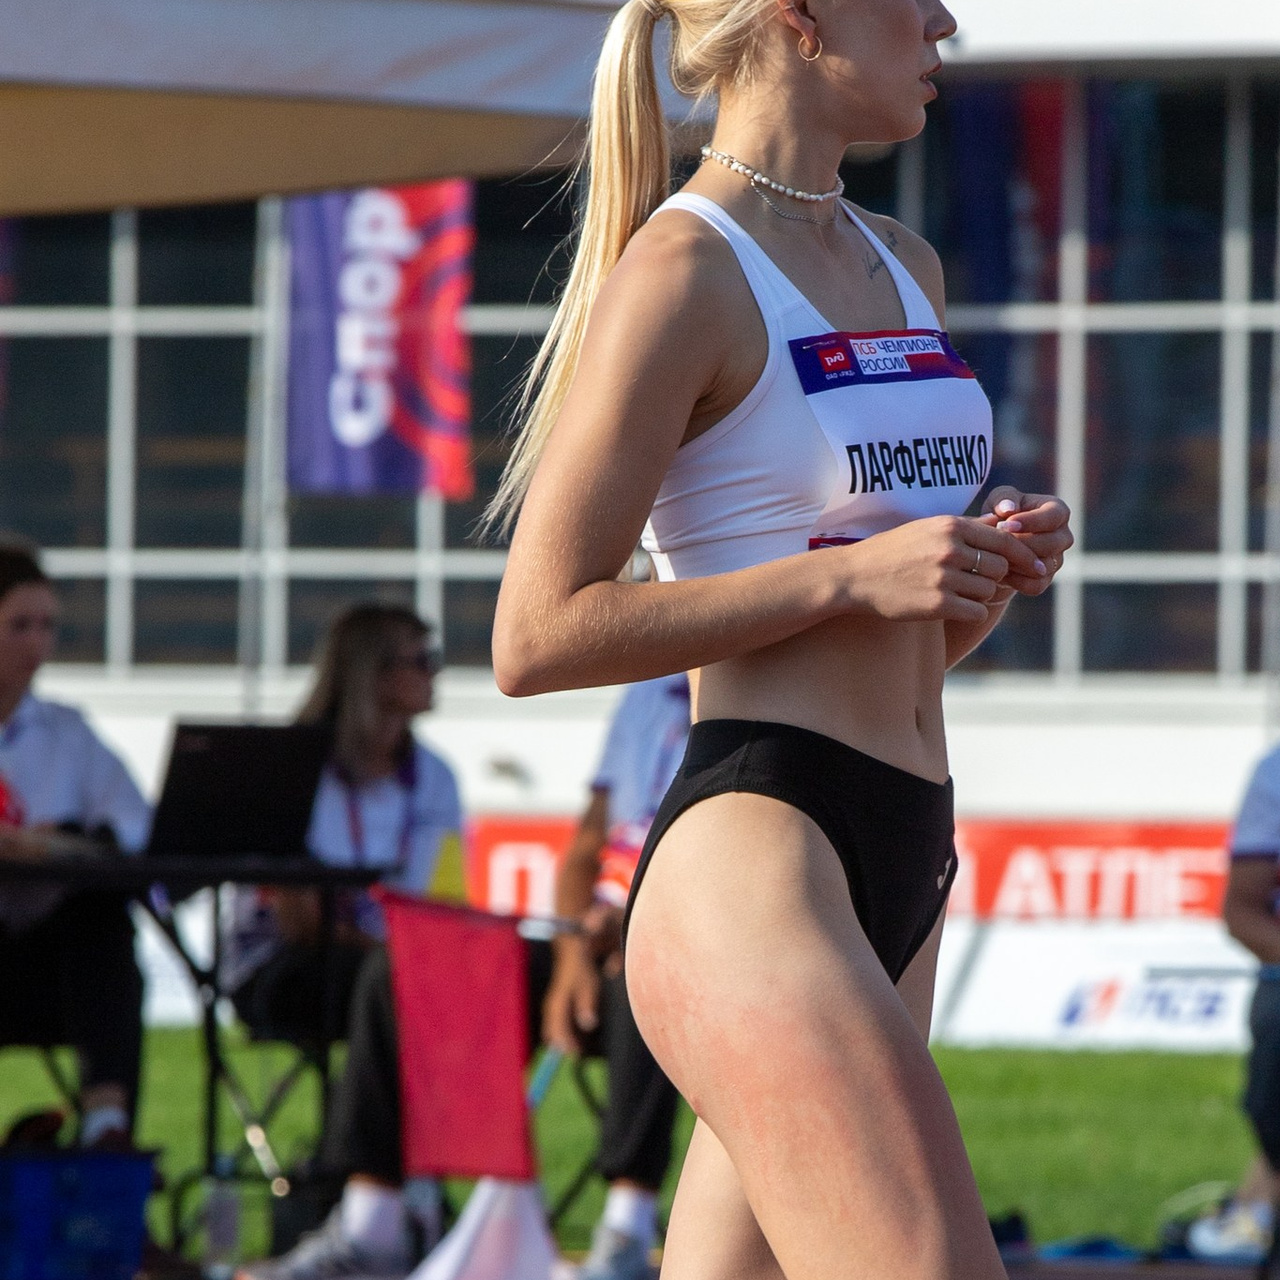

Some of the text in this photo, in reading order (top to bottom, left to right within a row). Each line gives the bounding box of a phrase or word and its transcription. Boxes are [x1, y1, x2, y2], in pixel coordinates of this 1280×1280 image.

[851, 337, 942, 356] ПСБ ЧЕМПИОНАТ
[859, 355, 909, 372] РОССИИ
[845, 434, 988, 494] ПАРФЕНЕНКО
